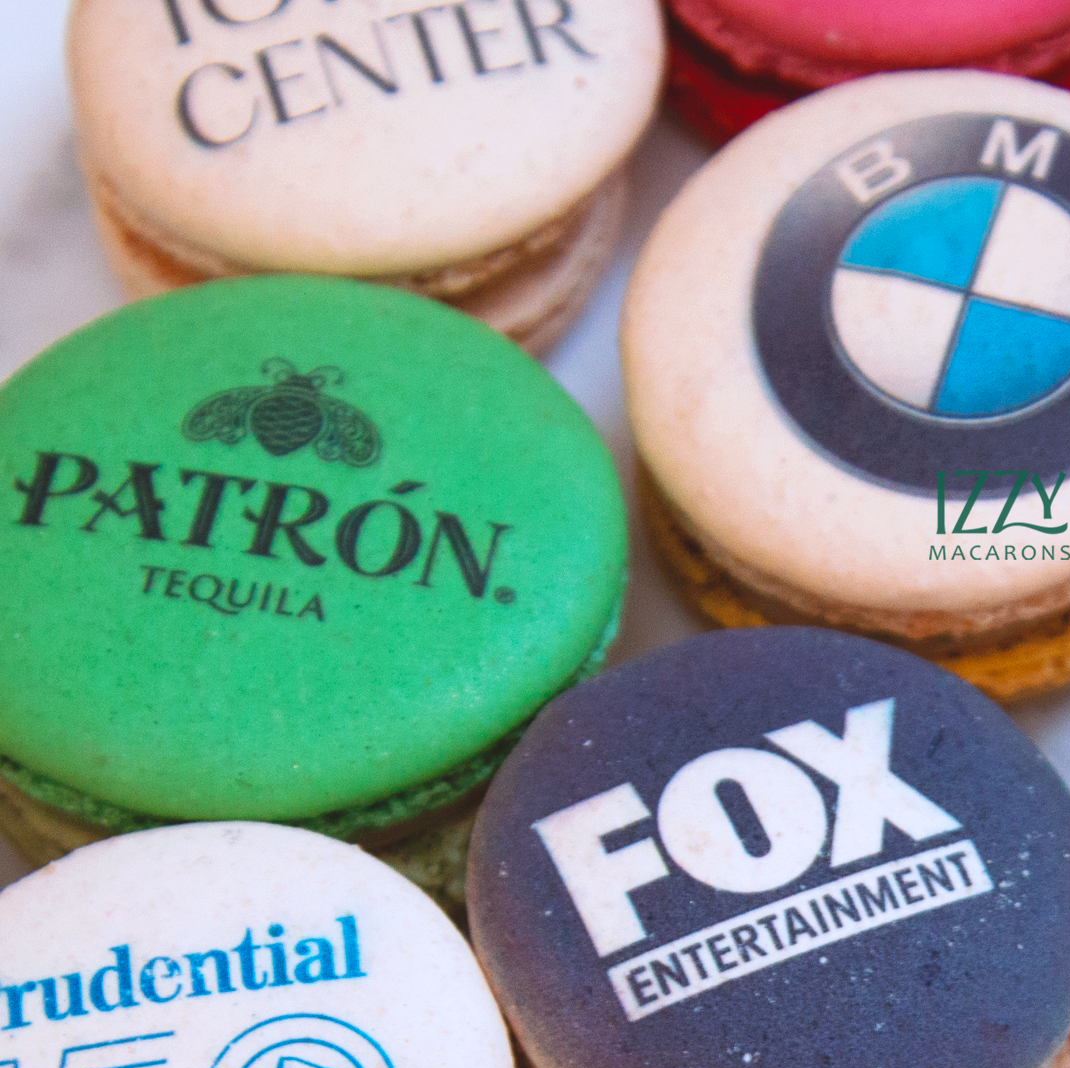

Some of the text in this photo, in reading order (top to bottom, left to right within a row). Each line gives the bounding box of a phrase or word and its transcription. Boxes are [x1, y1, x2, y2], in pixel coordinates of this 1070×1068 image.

[175, 0, 600, 150] CENTER
[139, 564, 327, 622] TEQUILA
[531, 697, 964, 958] FOX
[0, 914, 367, 1030] rudential
[626, 850, 975, 1008] ENTERTAINMENT
